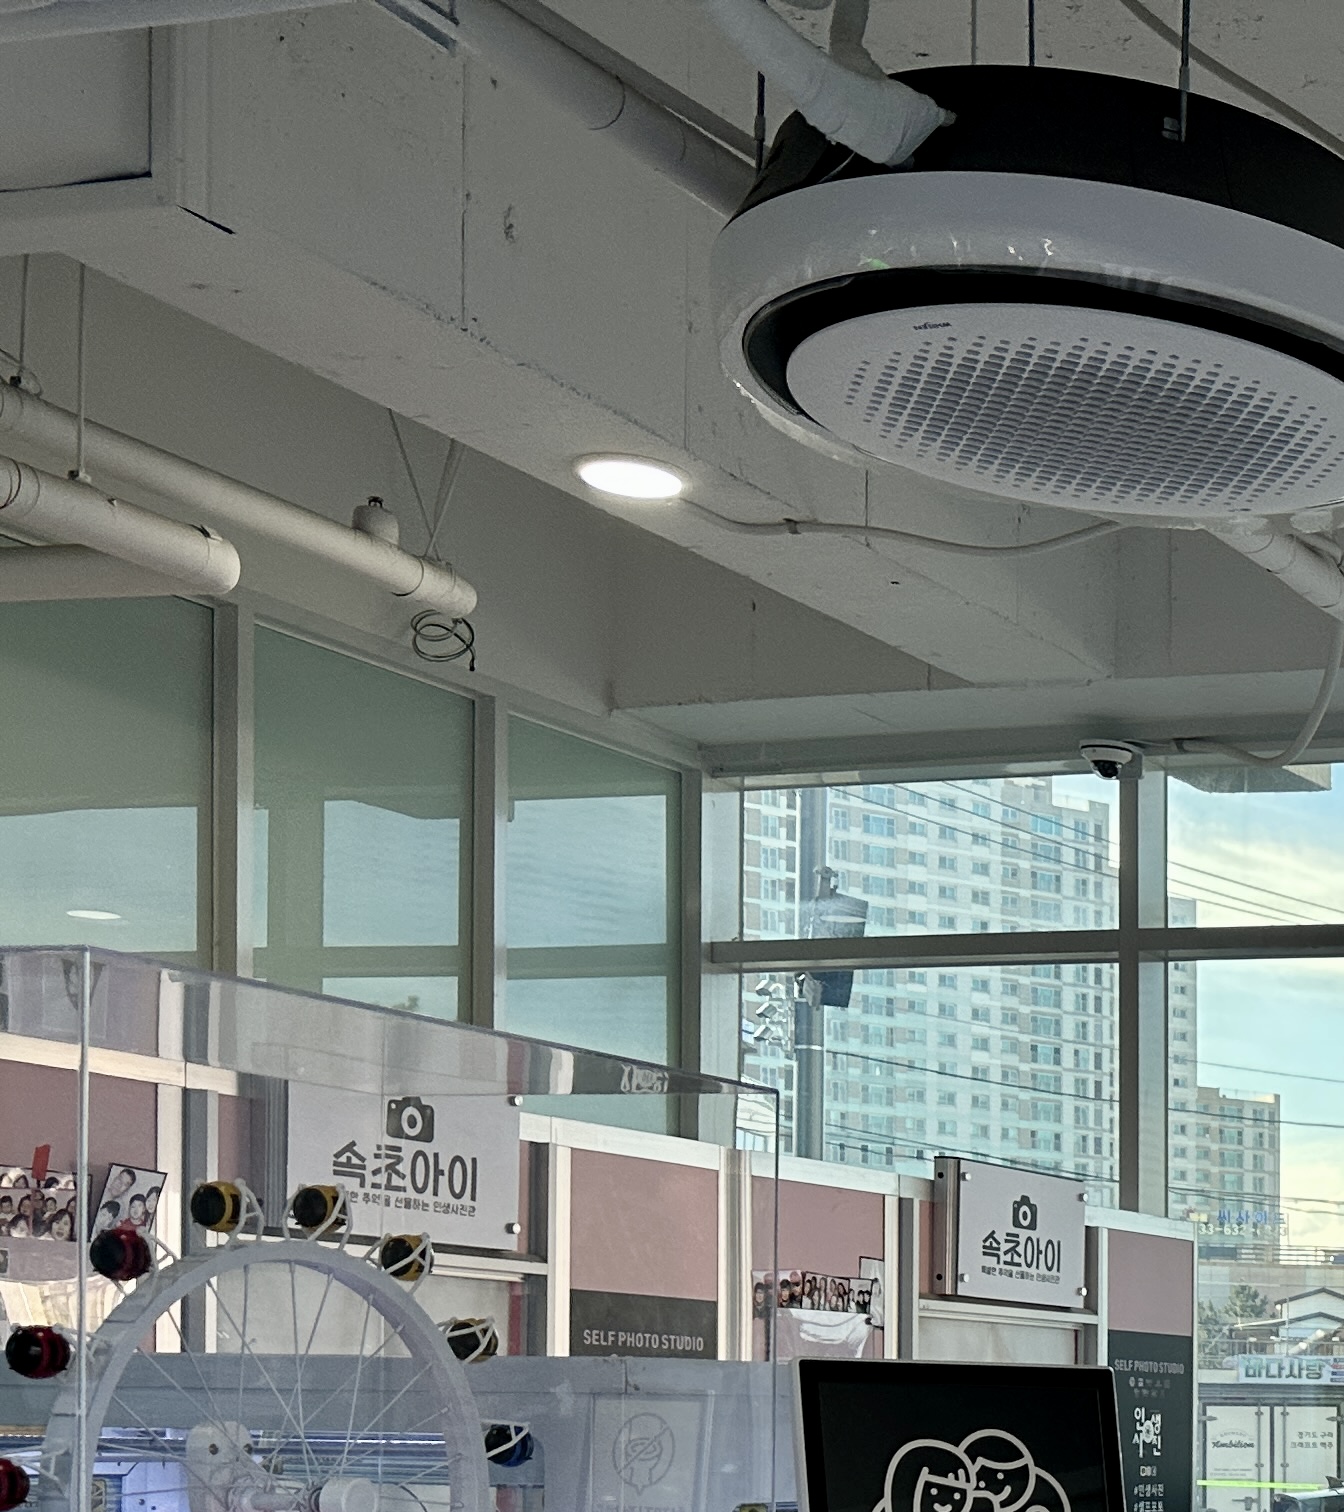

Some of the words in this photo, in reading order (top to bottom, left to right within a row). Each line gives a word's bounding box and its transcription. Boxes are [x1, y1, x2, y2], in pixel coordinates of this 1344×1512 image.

[332, 1139, 478, 1202] 속초아이
[982, 1229, 1061, 1273] 속초아이
[583, 1329, 617, 1347] SELF
[617, 1330, 660, 1349] PHOTO
[661, 1333, 704, 1351] STUDIO
[1114, 1358, 1133, 1371] SELF
[1134, 1360, 1158, 1373] PHOTO
[1244, 1357, 1327, 1380] 바다사랑
